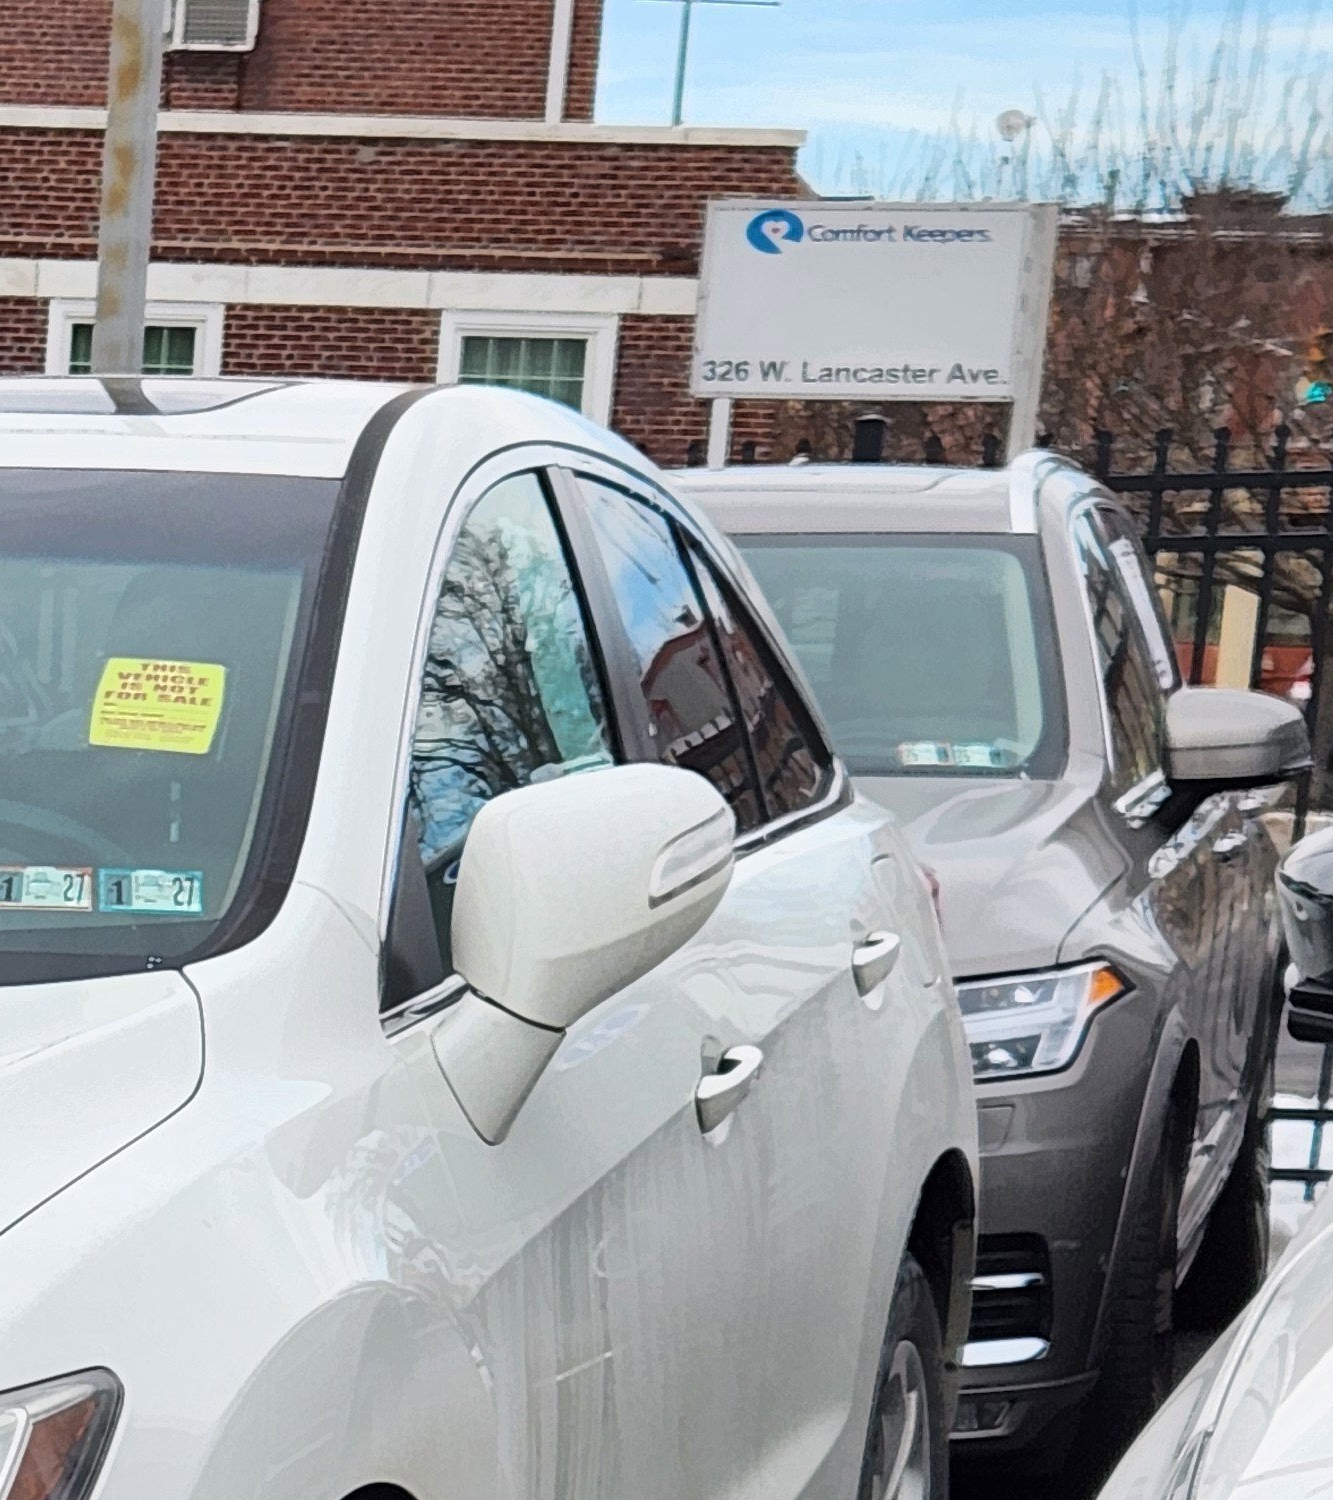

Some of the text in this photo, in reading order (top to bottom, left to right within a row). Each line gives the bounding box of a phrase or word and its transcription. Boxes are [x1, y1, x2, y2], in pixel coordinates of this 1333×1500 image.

[807, 224, 993, 245] Comfort Keepers
[701, 359, 1009, 386] 326 W. Lancaster Ave.
[140, 663, 191, 674] THIS
[118, 671, 210, 686] VEHICLE
[121, 682, 199, 695] IS NOT
[104, 690, 212, 707] FOR SALE
[63, 873, 84, 904] 27
[172, 876, 195, 907] 27
